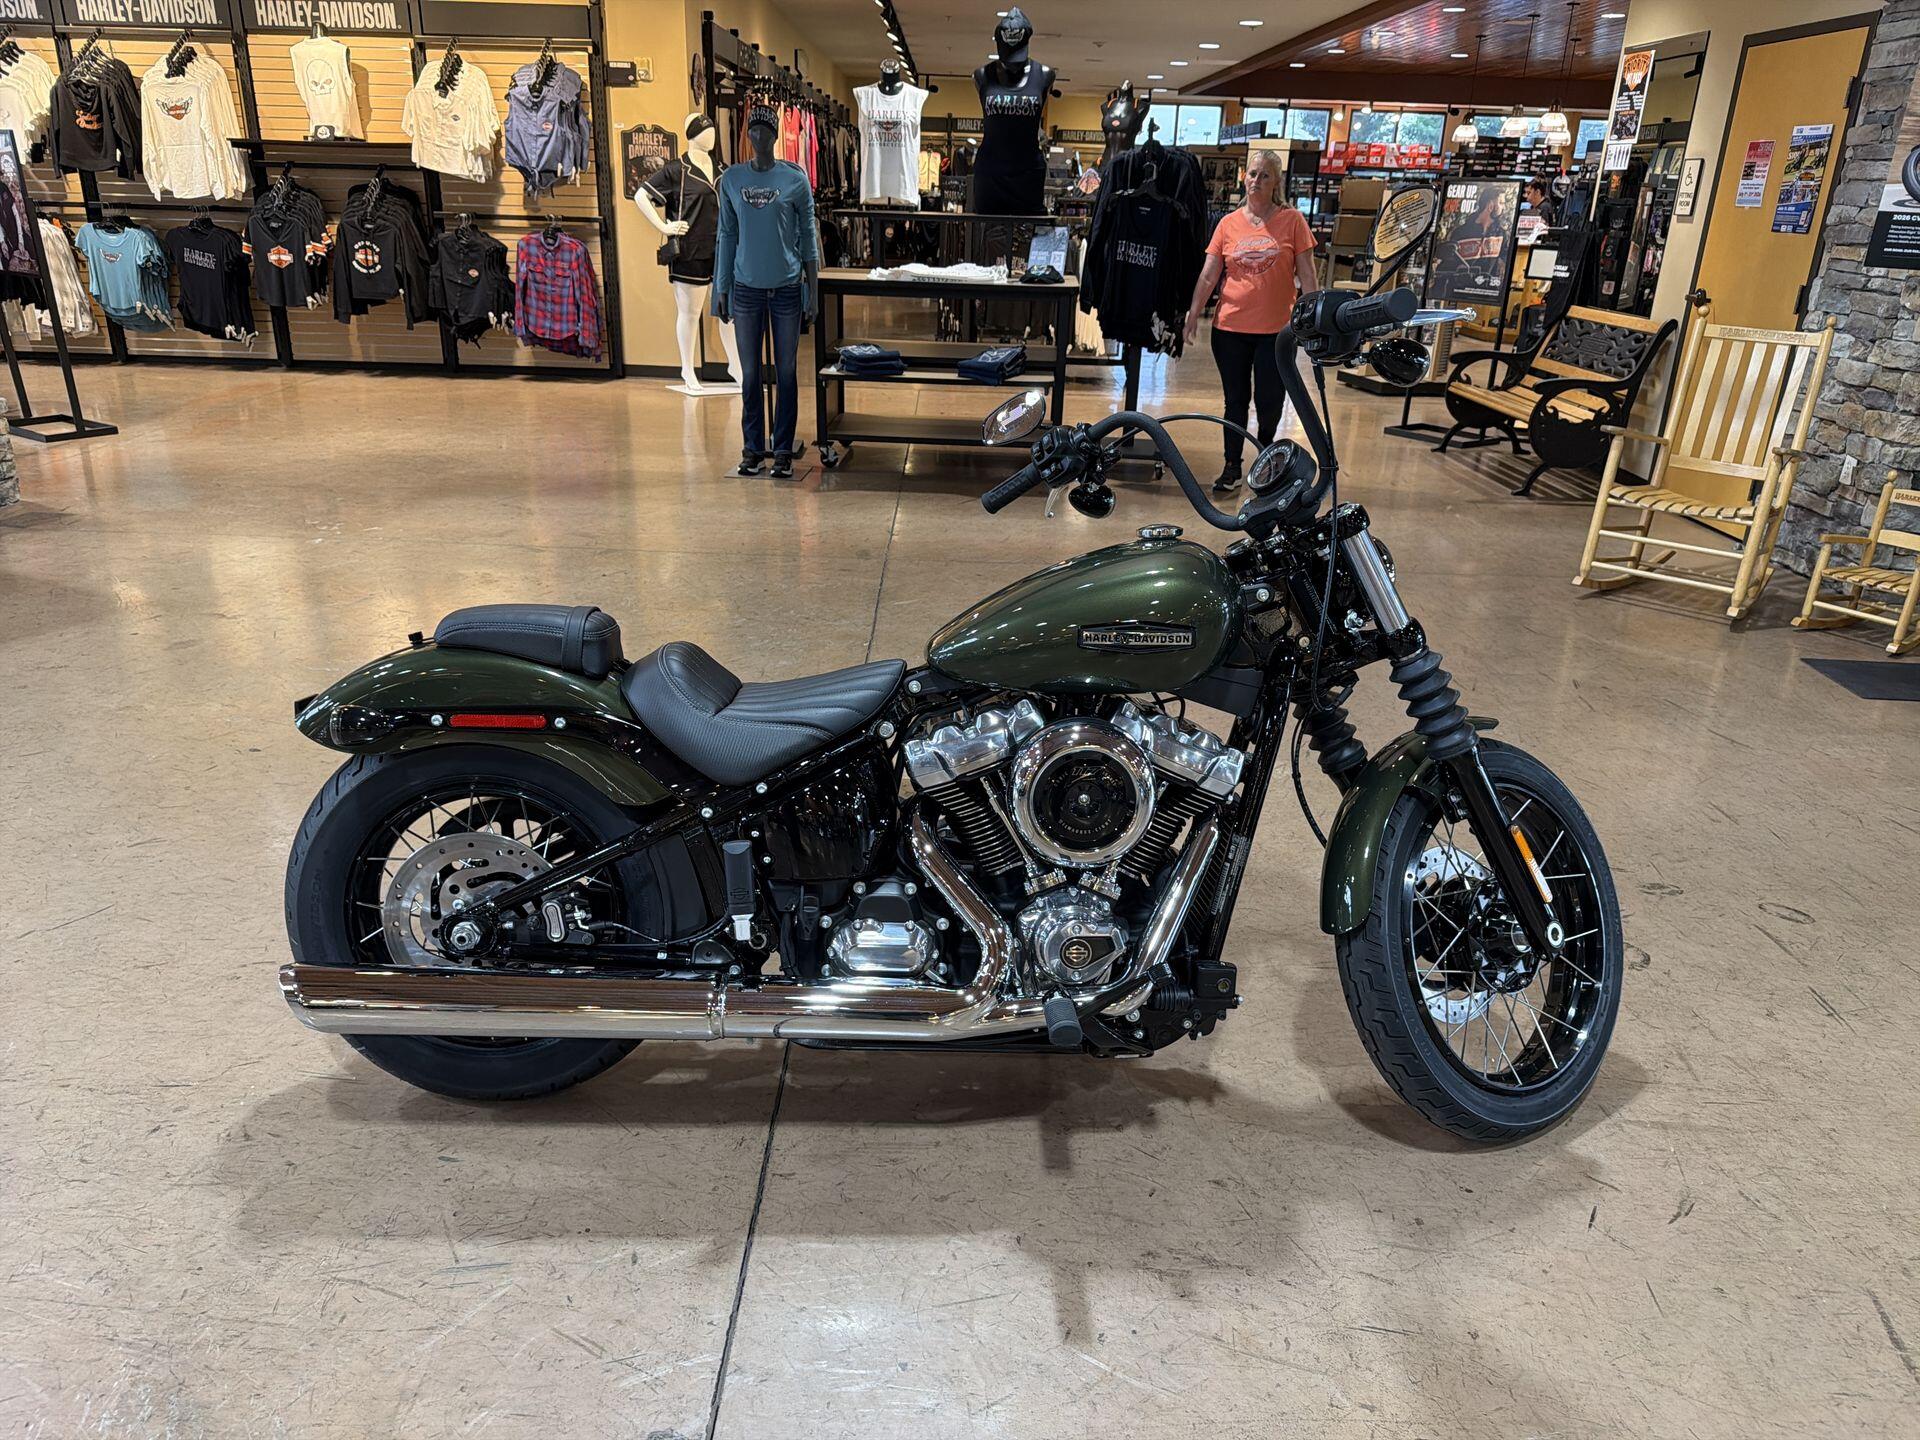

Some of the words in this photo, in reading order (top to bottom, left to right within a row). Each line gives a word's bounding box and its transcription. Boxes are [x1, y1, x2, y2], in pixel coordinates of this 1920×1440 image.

[76, 0, 218, 25] HARLEY-DAVIDSON
[254, 0, 397, 29] HARLEY-DAVIDSON
[632, 132, 667, 146] HARLEY-
[868, 132, 907, 143] DAVIDSO
[628, 144, 671, 159] DAVIDSON
[1447, 184, 1465, 199] GEAR
[1466, 184, 1478, 199] UP.
[1085, 632, 1190, 644] HARLEY-DAVIDSON
